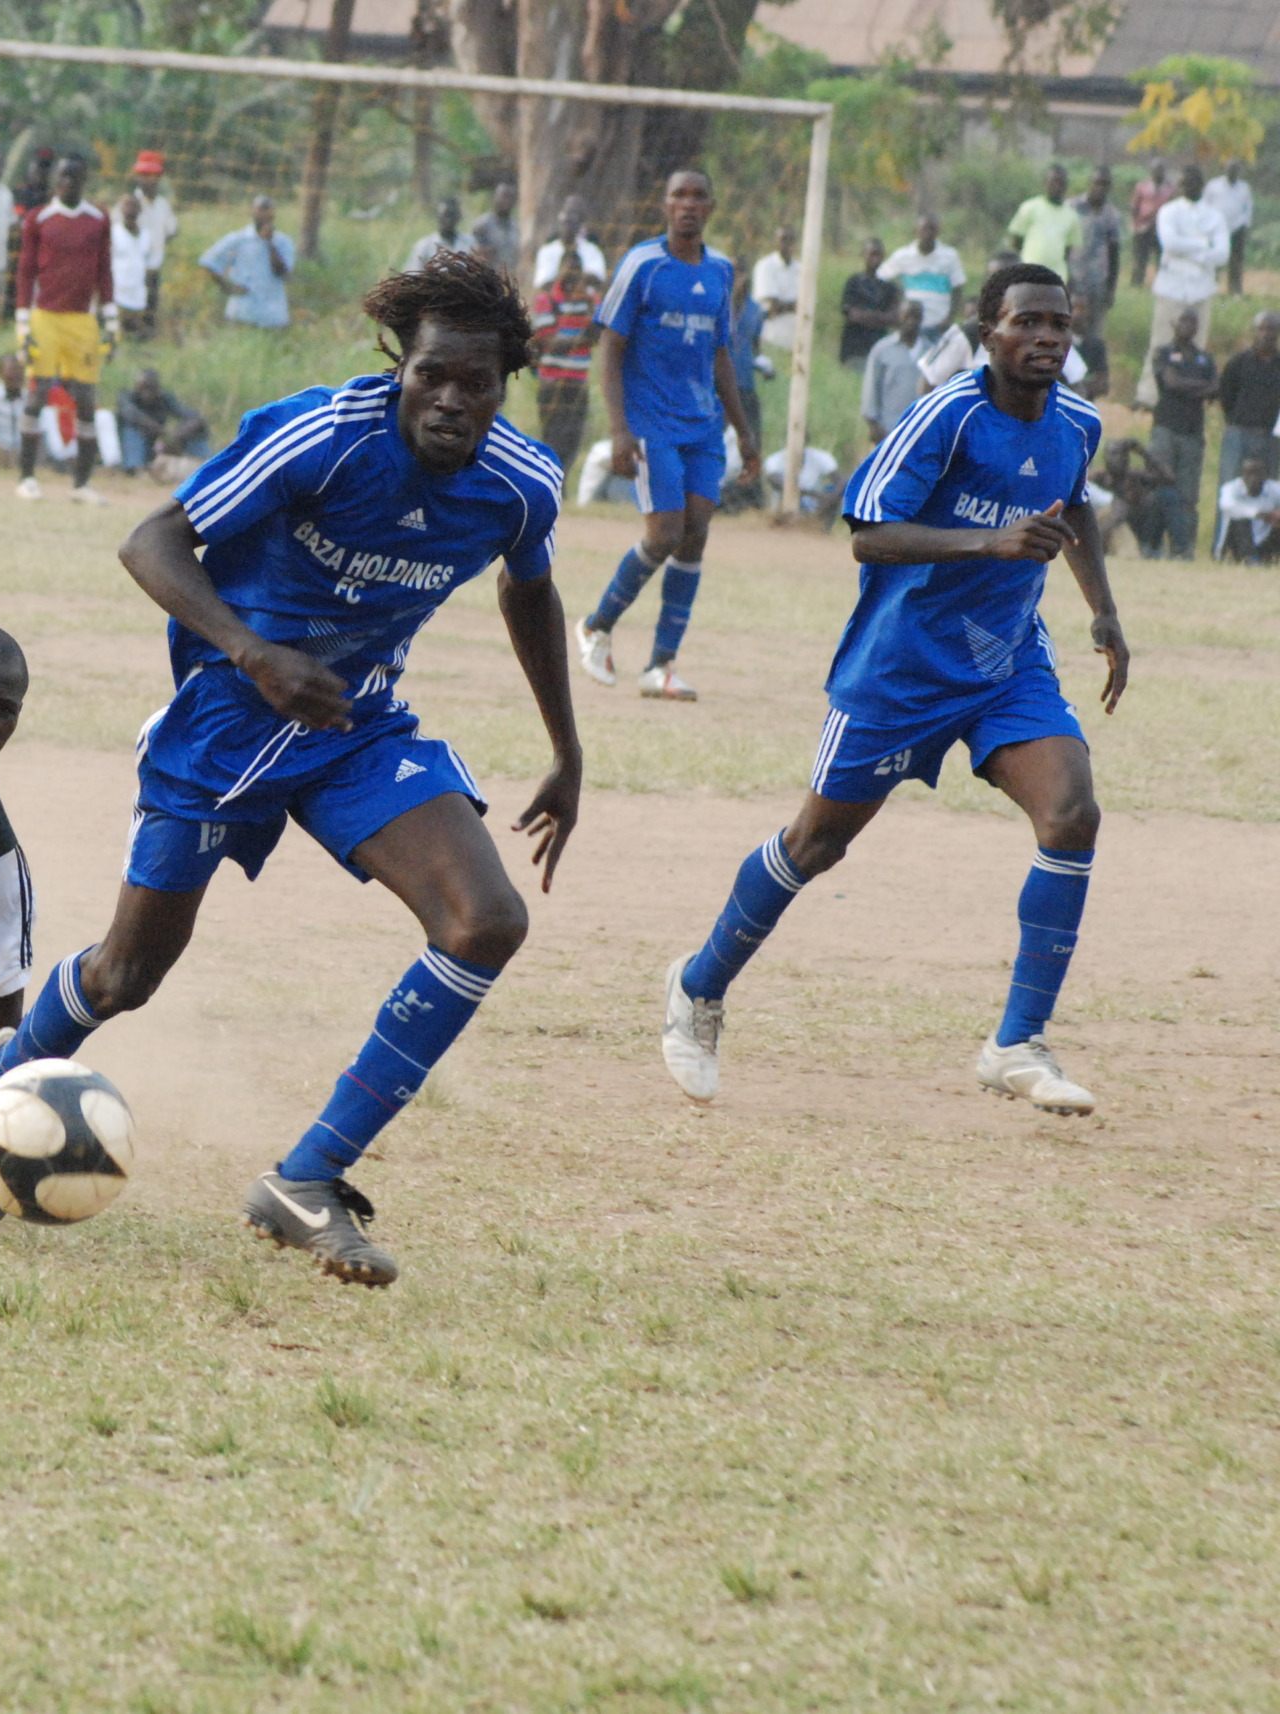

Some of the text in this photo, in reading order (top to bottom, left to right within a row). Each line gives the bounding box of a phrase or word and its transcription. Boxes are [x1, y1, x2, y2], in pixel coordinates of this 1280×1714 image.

[396, 519, 428, 531] adidas
[953, 492, 999, 527] BAZA
[293, 521, 454, 590] BAZA HOLDINGS
[334, 576, 366, 605] FC
